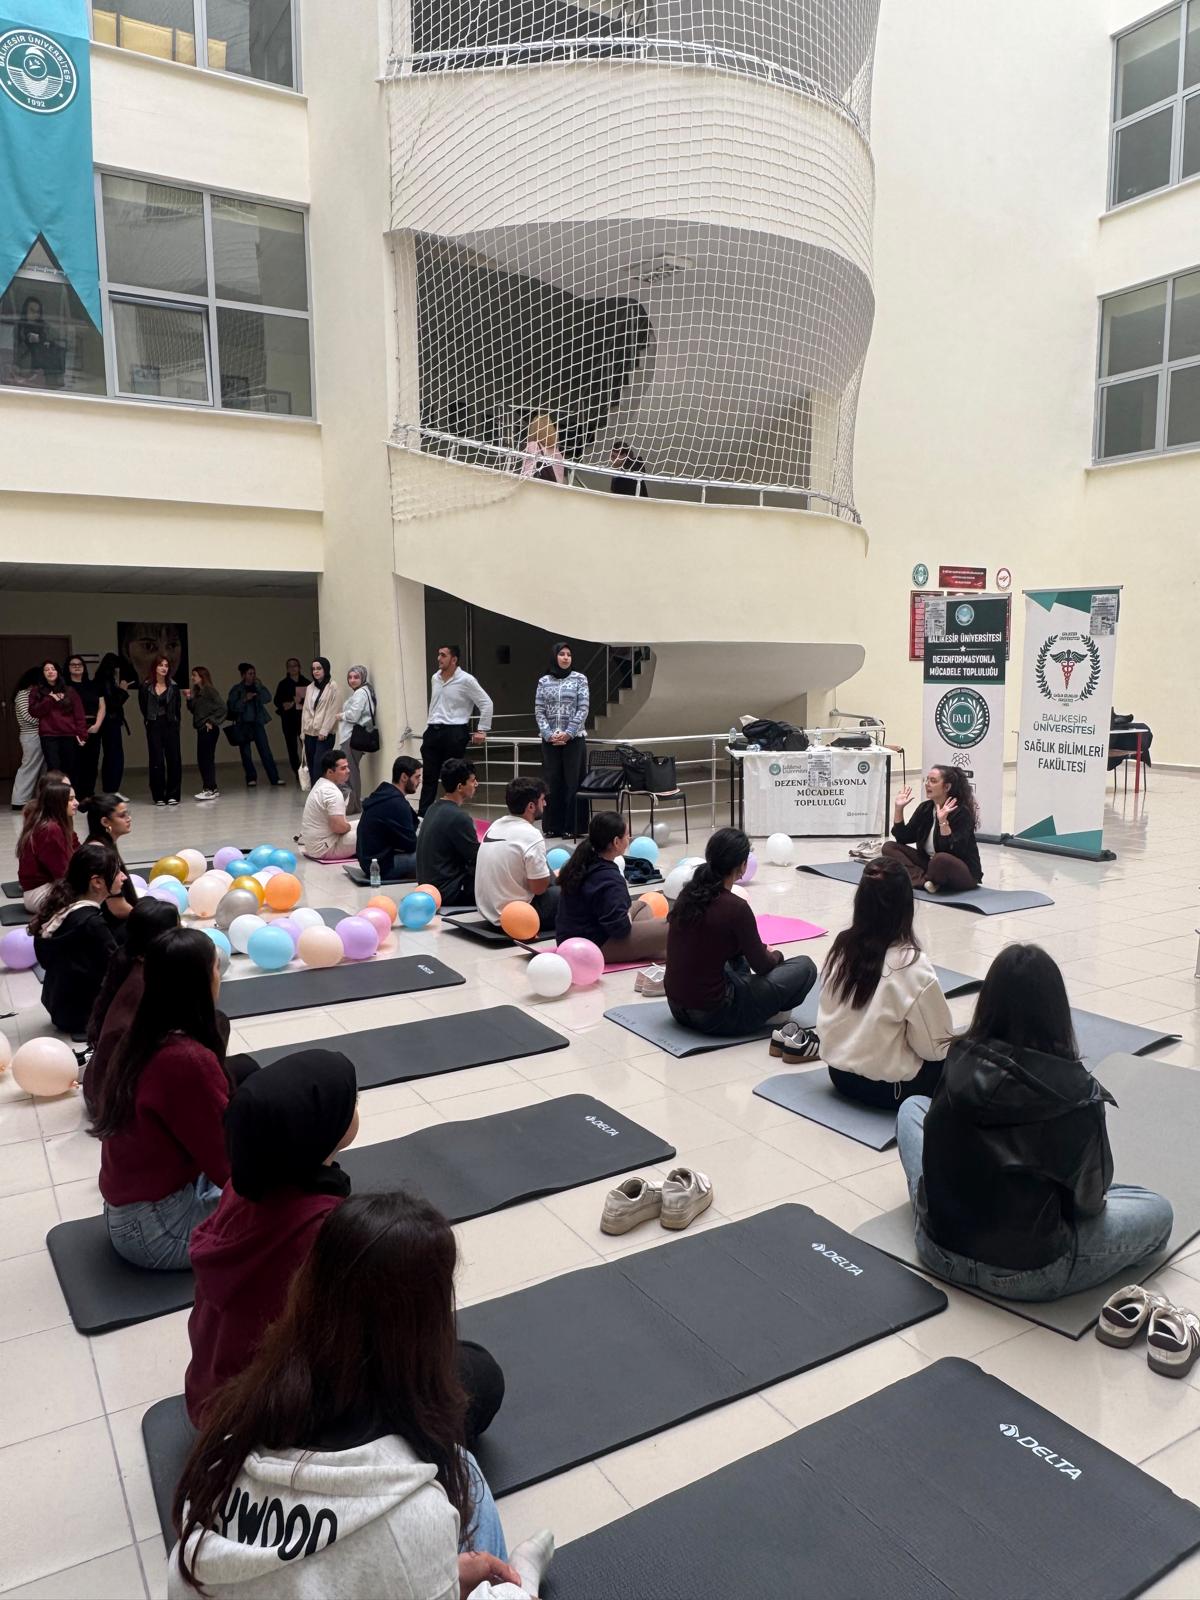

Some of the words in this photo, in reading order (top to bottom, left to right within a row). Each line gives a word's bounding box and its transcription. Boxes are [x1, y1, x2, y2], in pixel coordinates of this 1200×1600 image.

[27, 34, 73, 84] ÜNİVERSİTESİ
[960, 632, 1002, 643] ÜNİVERSİTESİ
[932, 655, 996, 664] DEZENFORMASYONLA
[929, 666, 961, 676] MÜCADELE
[963, 666, 999, 676] TOPLULUĞU
[1042, 713, 1088, 724] BALIKESİR
[1033, 721, 1096, 735] ÜNİVERSİTESİ
[1024, 739, 1056, 753] SAĞLIK
[1058, 741, 1104, 758] BİLİMLERİ
[1038, 758, 1087, 773] FAKÜLTESİ
[797, 788, 845, 797] MÜCADELE
[794, 798, 847, 807] TOPLULUĞU
[822, 1250, 864, 1276] DELTA
[1016, 1436, 1082, 1481] DELTA
